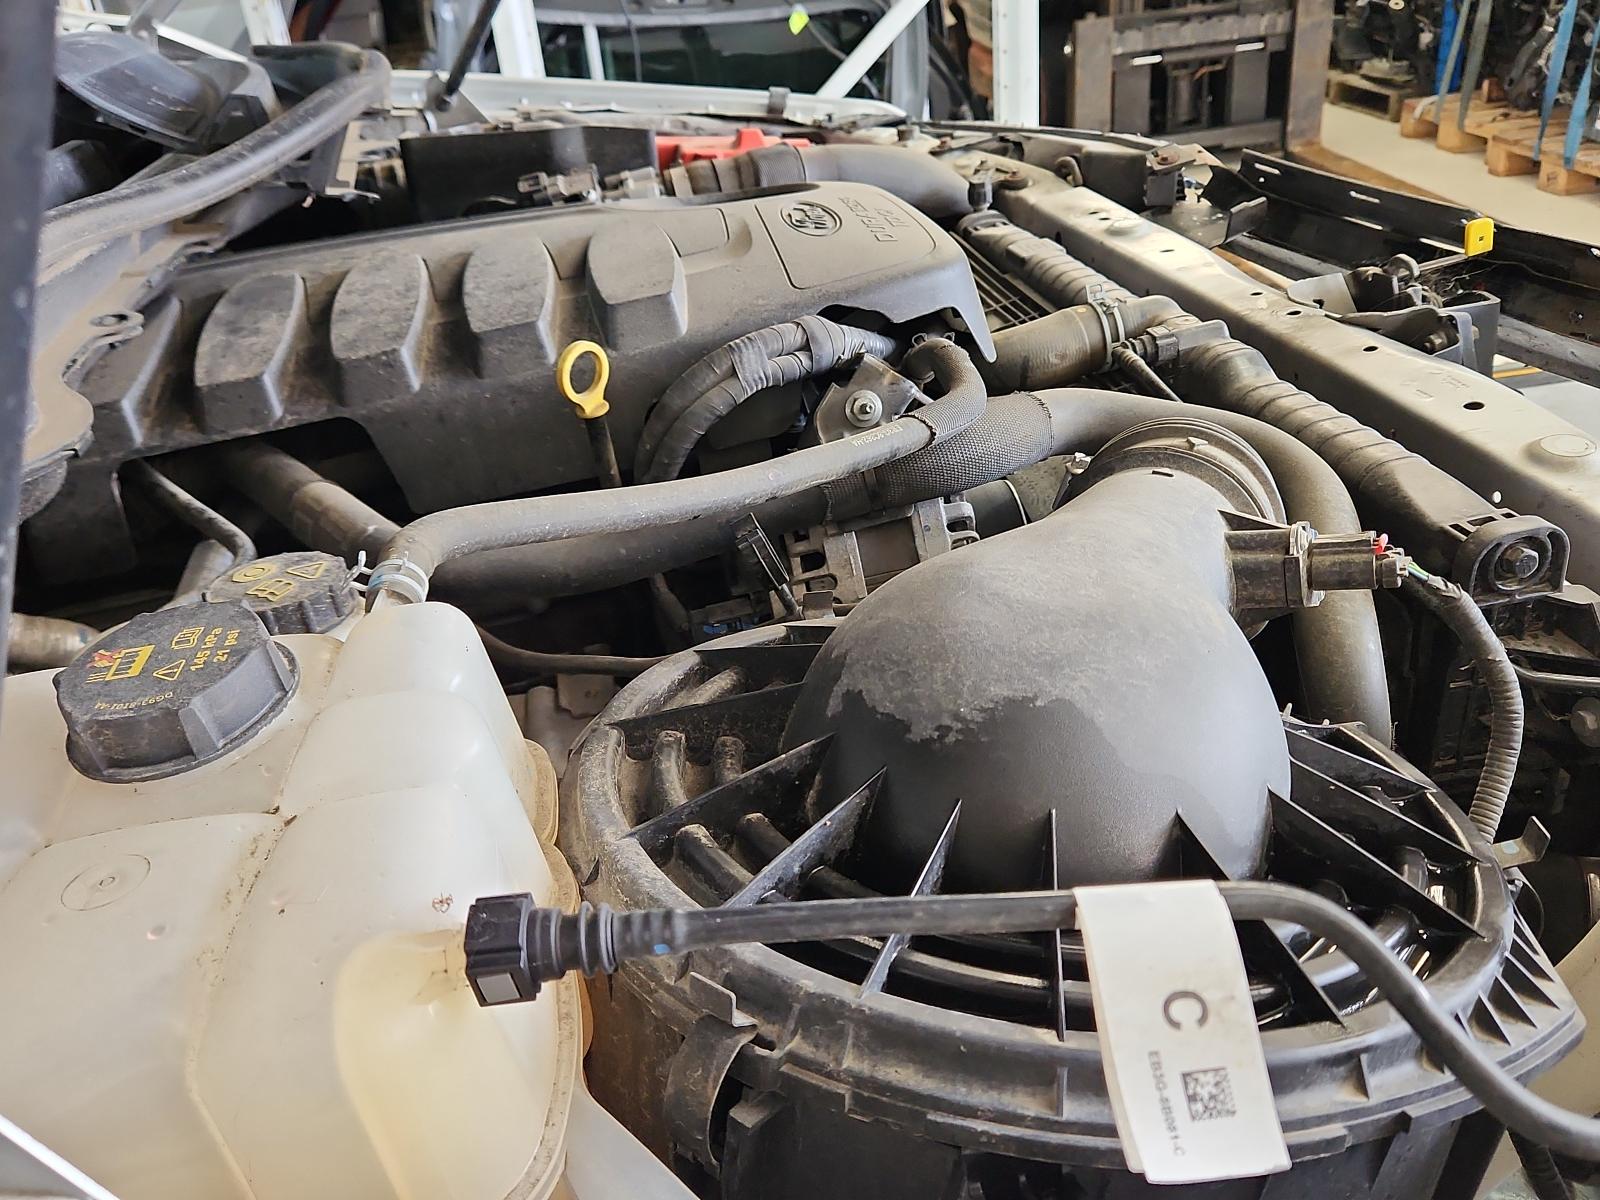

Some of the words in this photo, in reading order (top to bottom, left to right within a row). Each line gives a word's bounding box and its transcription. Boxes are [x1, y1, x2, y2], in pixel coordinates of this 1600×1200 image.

[190, 650, 210, 673] 145
[204, 627, 225, 650] kPa
[213, 649, 231, 664] 21
[224, 628, 241, 647] psi
[1164, 990, 1209, 1031] C
